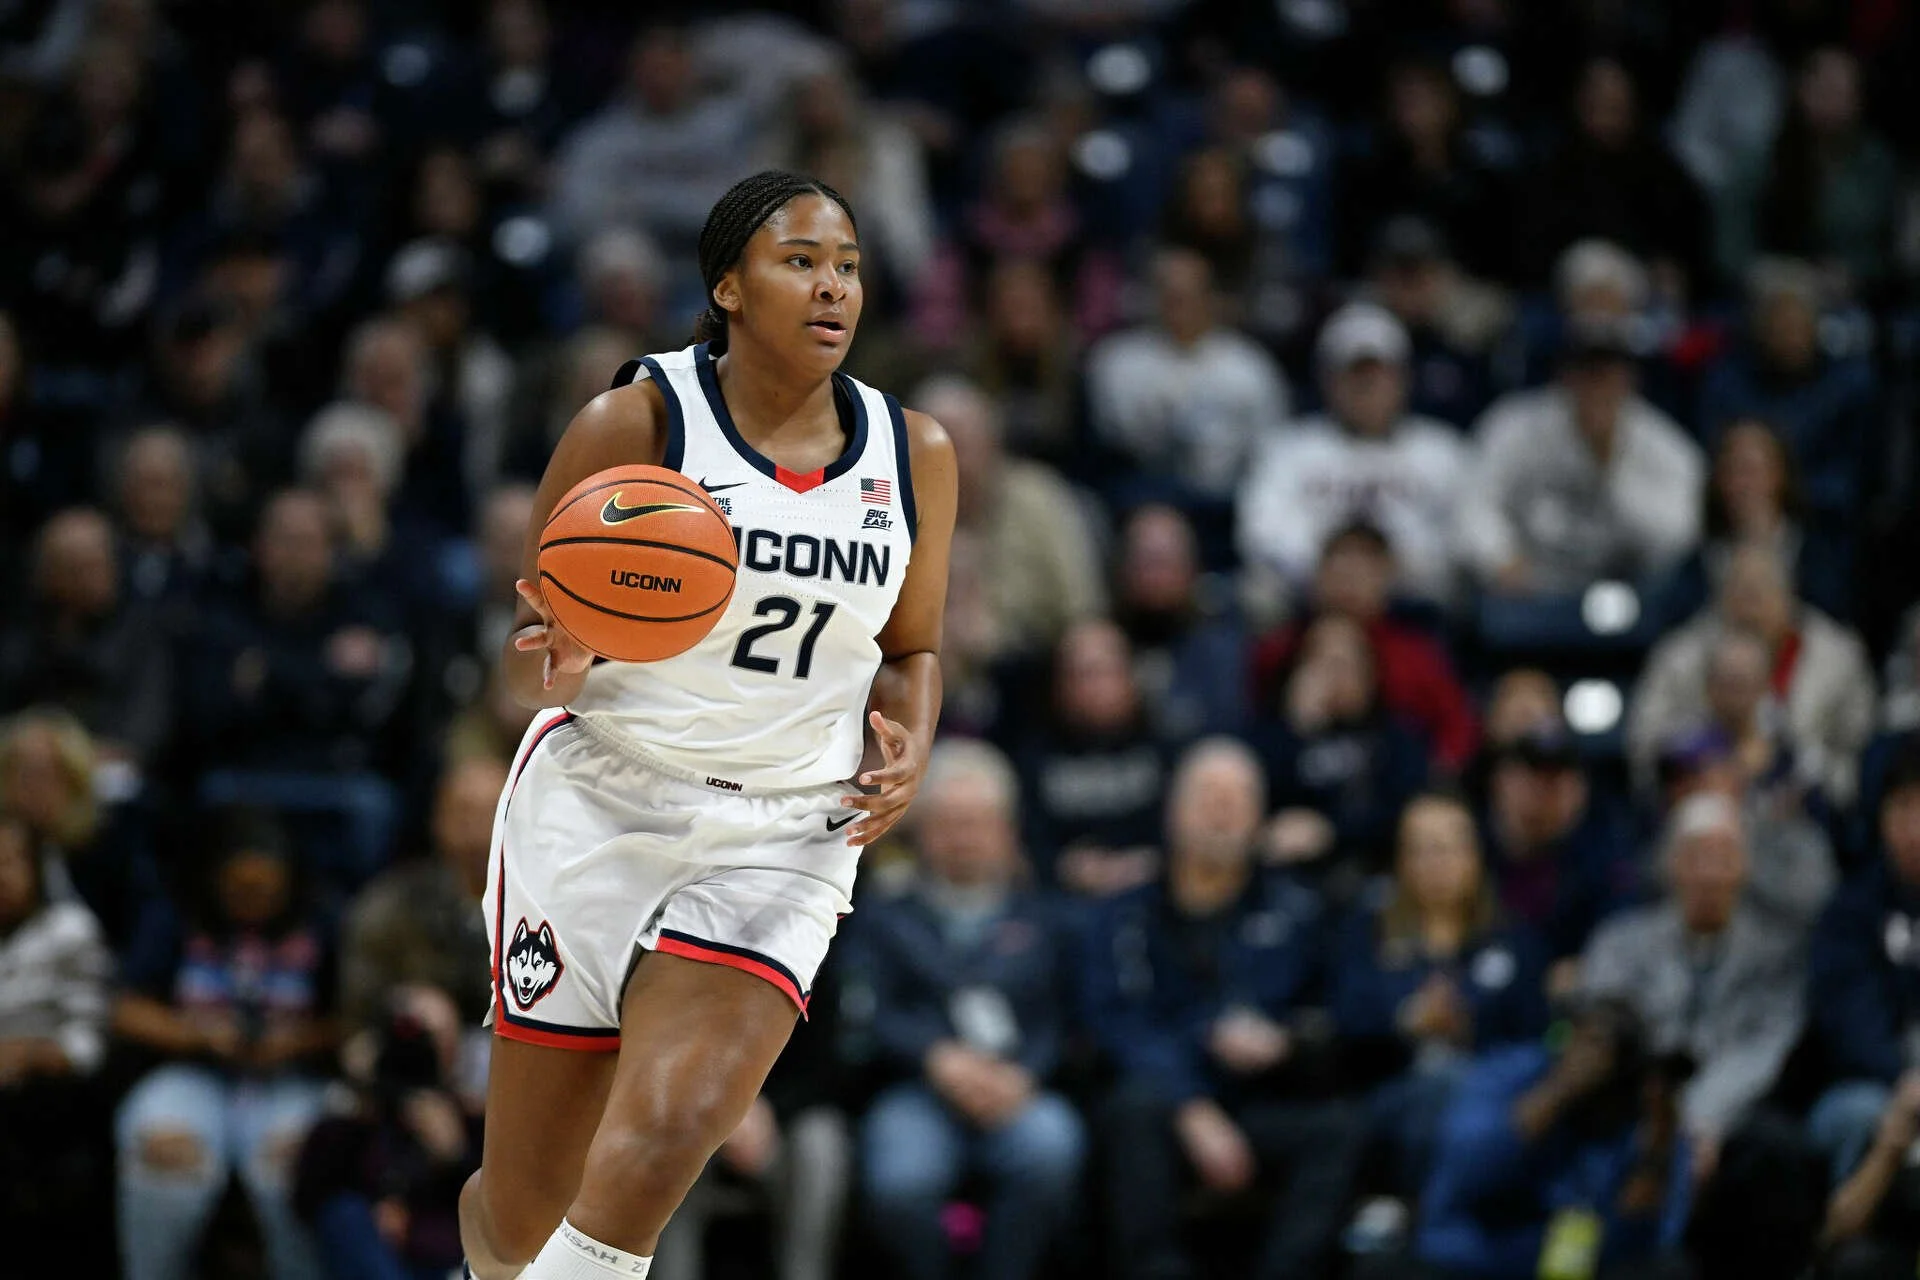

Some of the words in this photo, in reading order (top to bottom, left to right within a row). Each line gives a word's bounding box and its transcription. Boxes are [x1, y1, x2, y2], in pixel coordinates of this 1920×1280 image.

[712, 497, 731, 506] THE
[866, 508, 888, 520] BIG
[863, 517, 893, 529] EAST
[610, 569, 683, 593] UCONN
[729, 594, 838, 680] 21
[705, 776, 743, 792] UCONN
